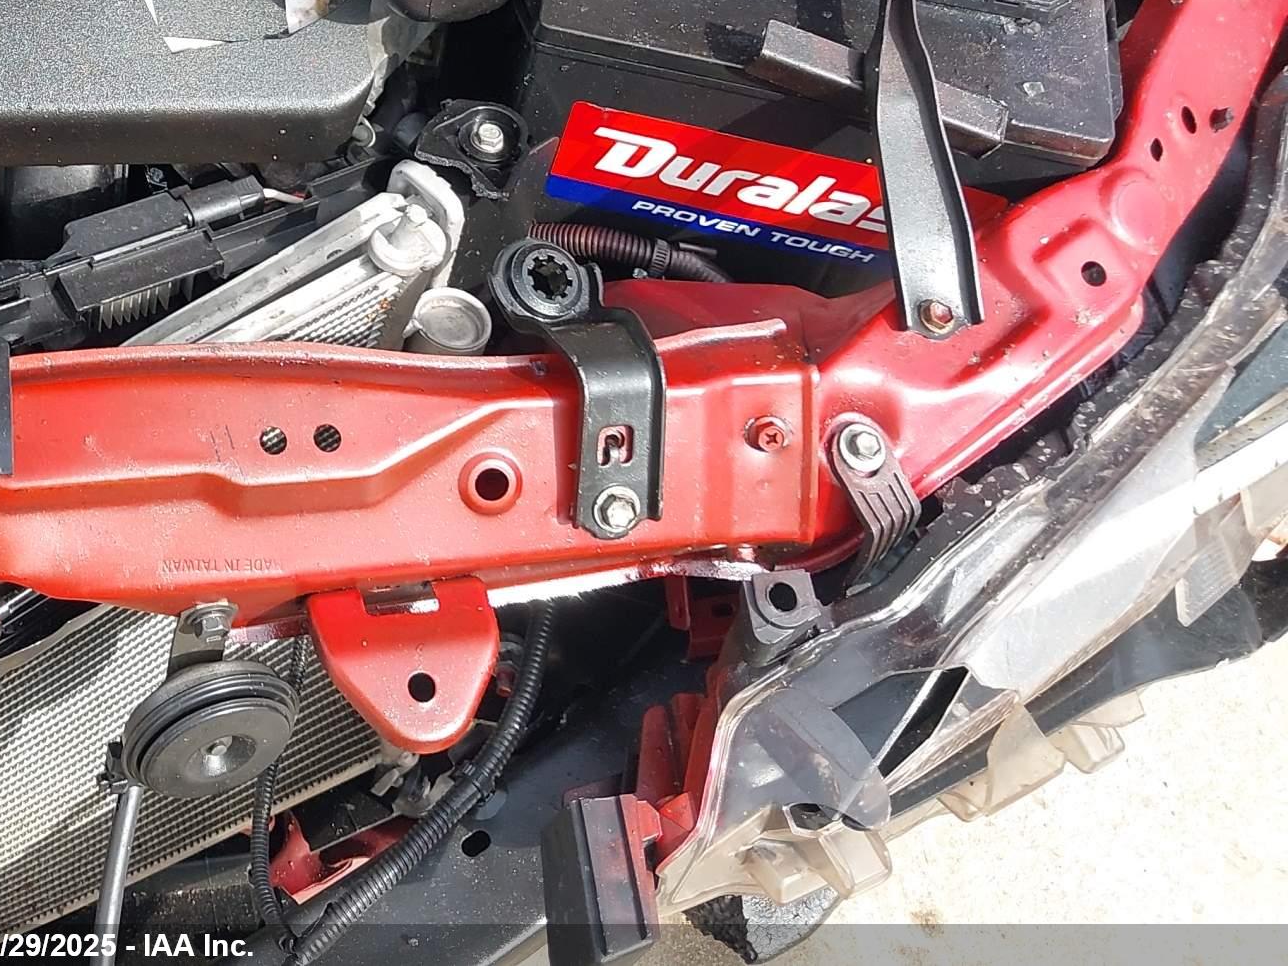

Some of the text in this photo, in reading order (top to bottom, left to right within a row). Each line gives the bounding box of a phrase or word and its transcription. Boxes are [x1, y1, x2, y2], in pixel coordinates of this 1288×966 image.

[632, 200, 878, 263] PROVEN TOUGH
[162, 558, 219, 573] TAIWAN
[224, 558, 240, 572] IN
